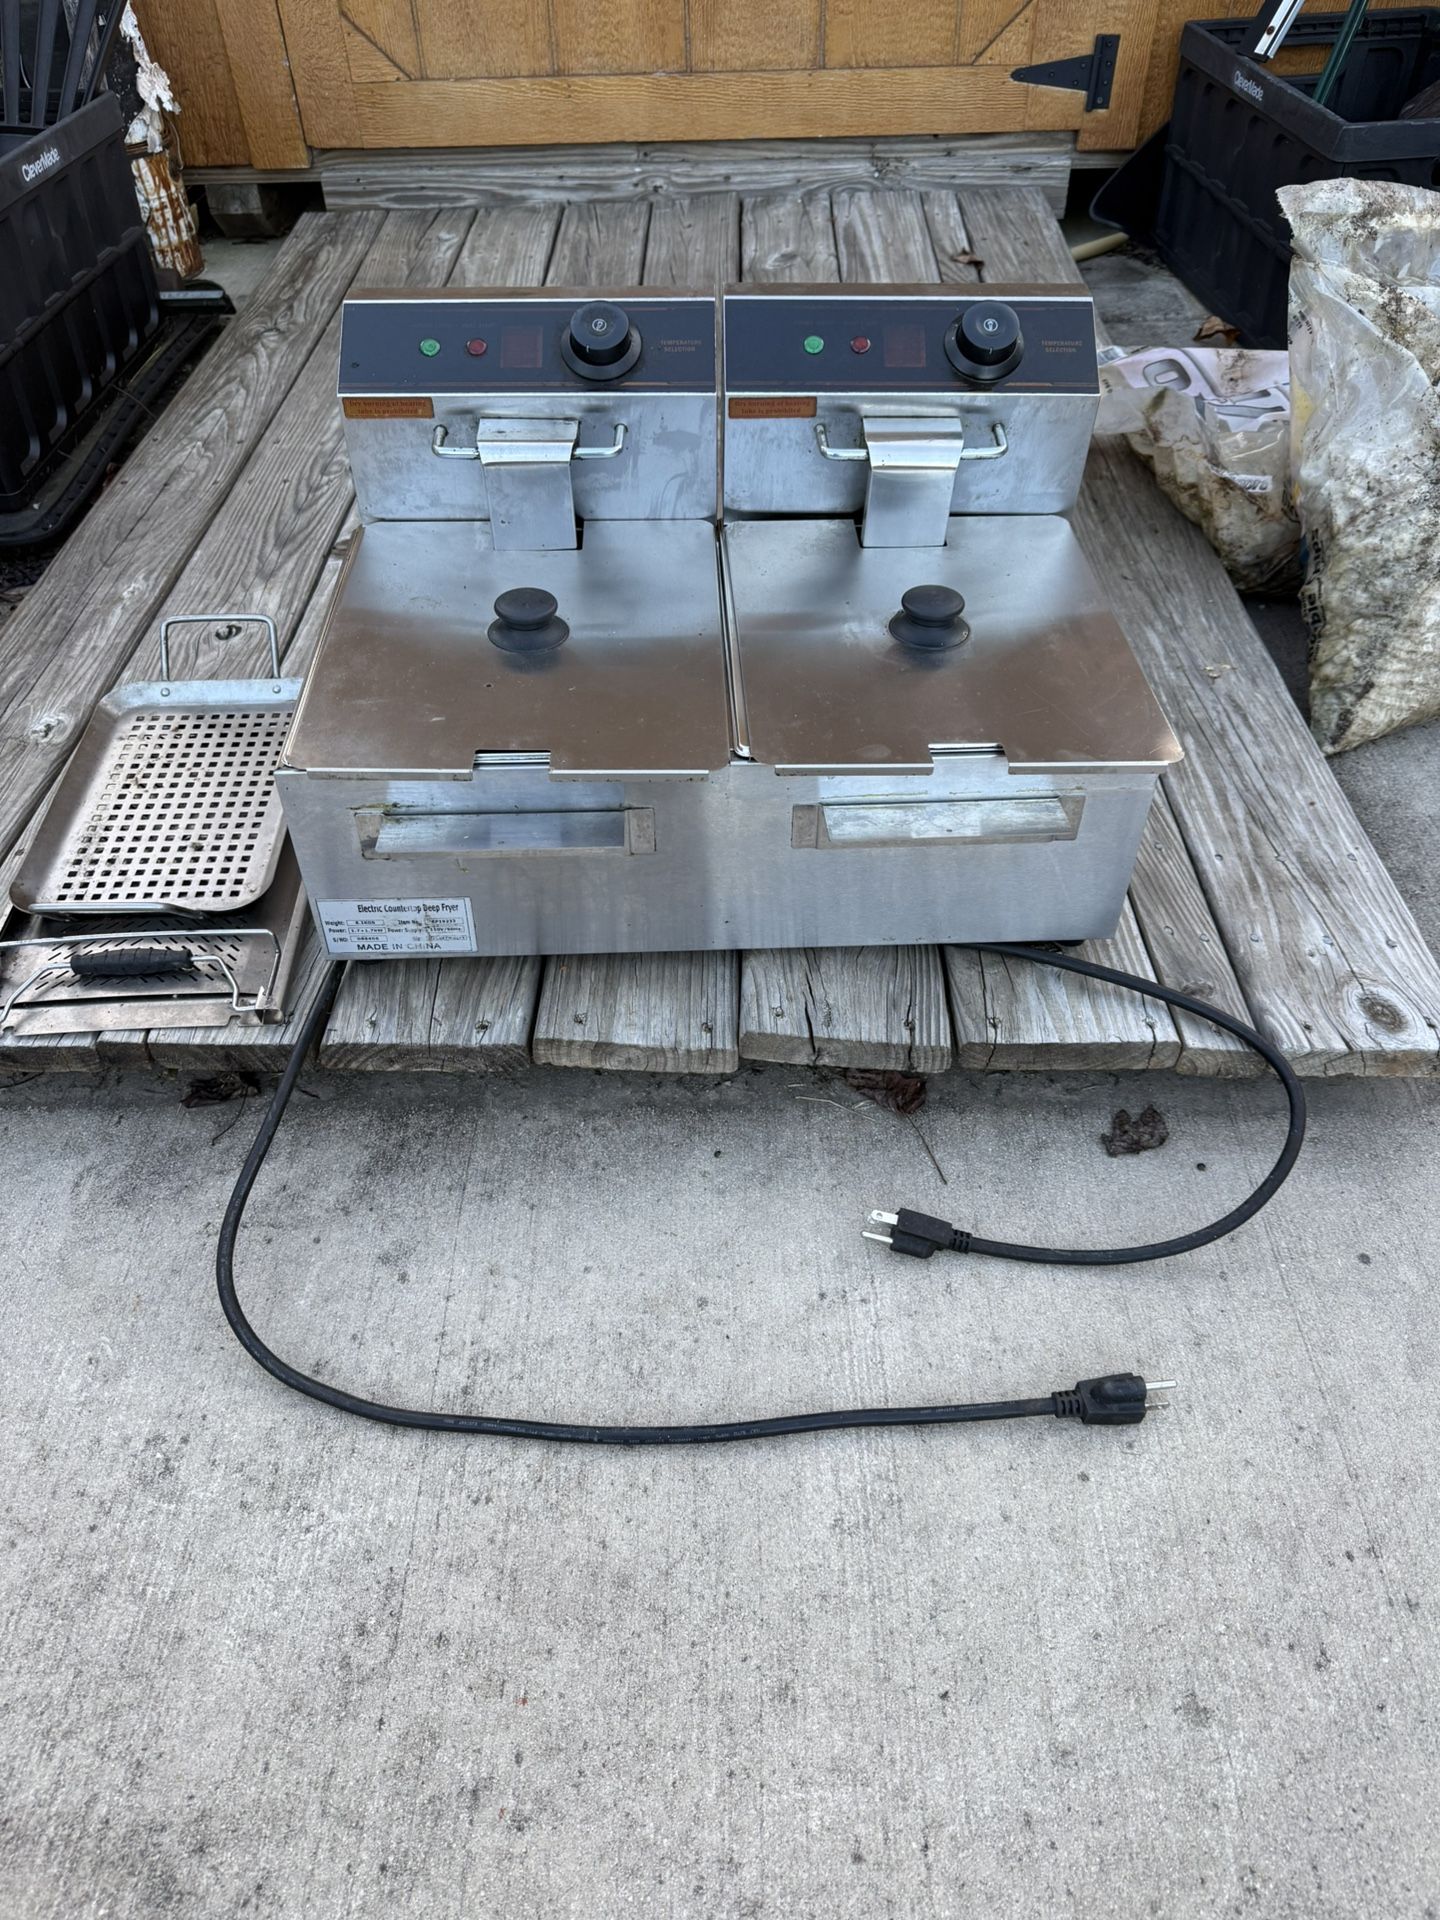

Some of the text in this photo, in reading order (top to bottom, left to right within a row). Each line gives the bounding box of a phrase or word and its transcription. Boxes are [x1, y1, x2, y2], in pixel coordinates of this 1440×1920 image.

[22, 147, 60, 182] CleverMade
[357, 903, 459, 914] Electric Countertop Deep Fryer
[356, 943, 388, 951] MADE
[406, 942, 442, 950] CHINA
